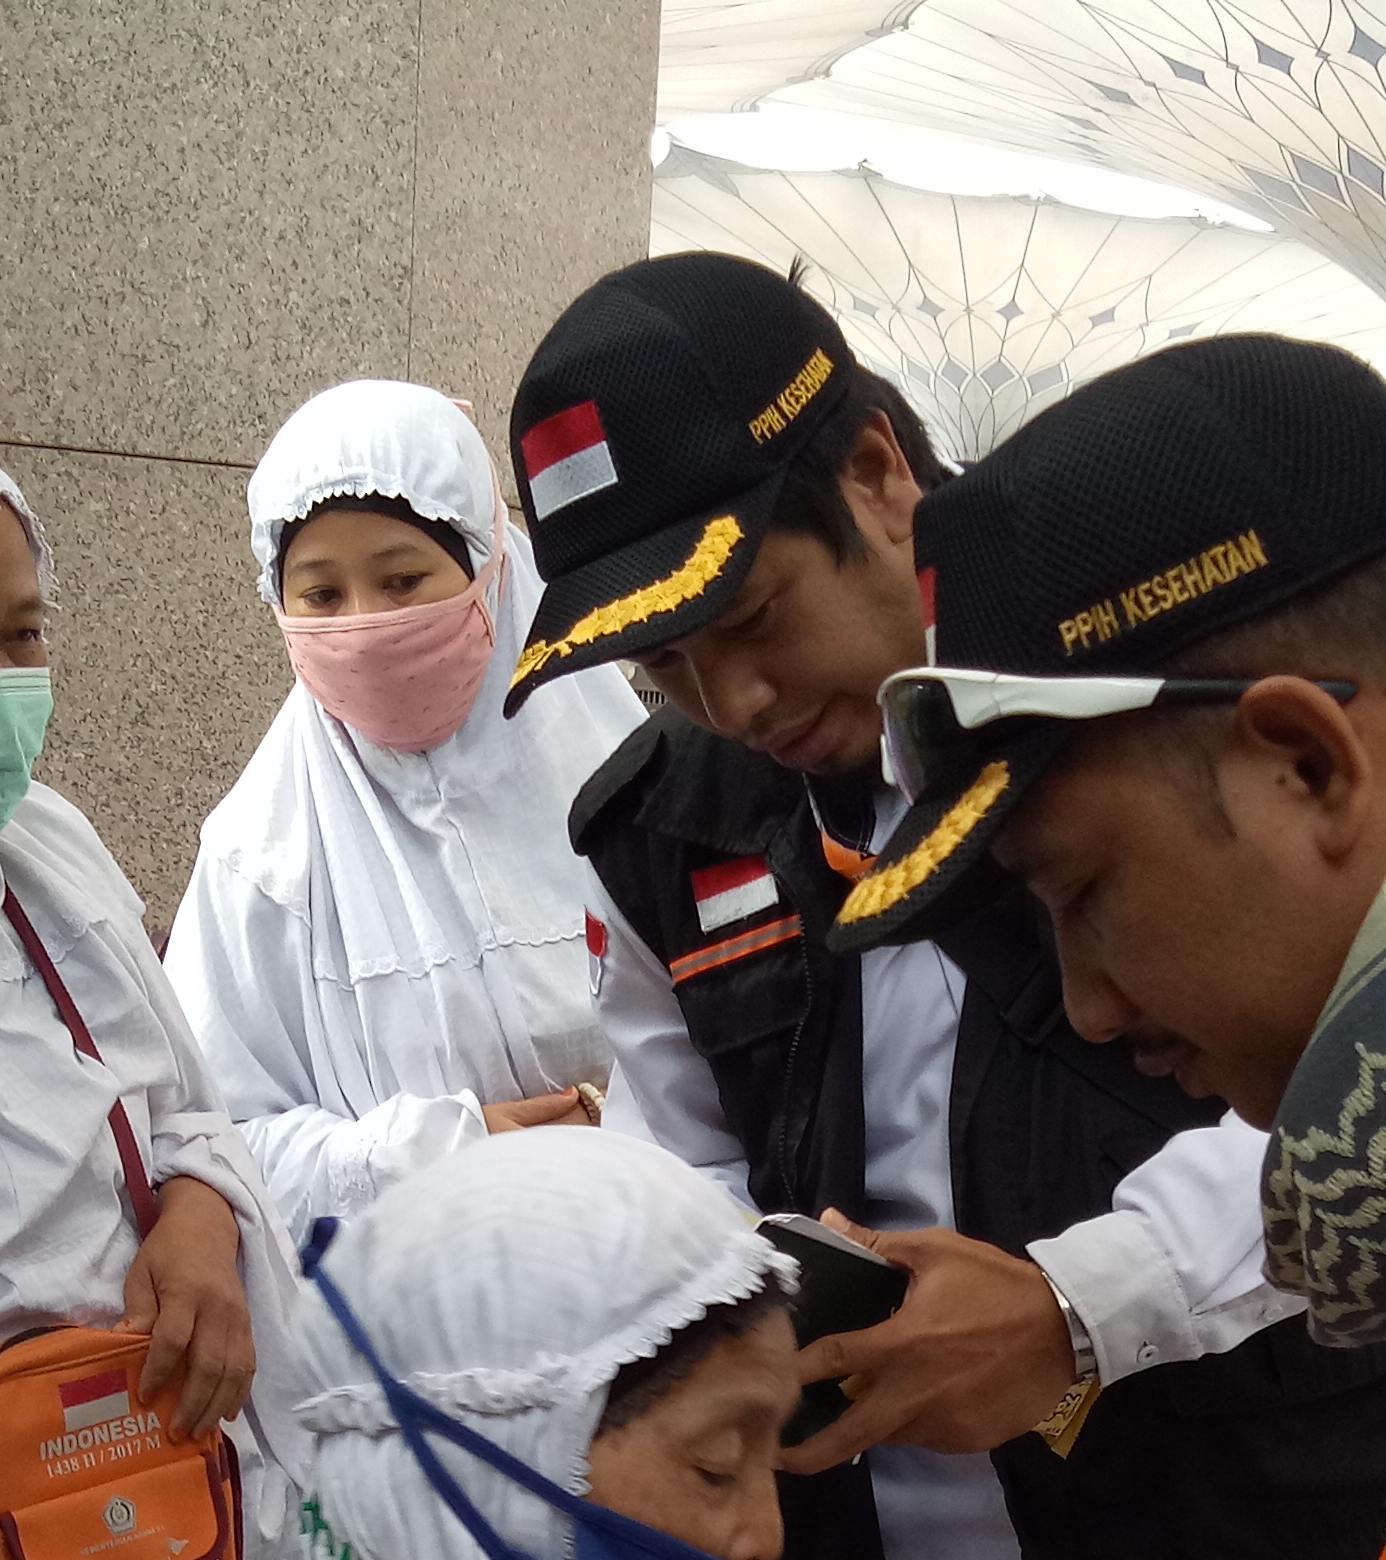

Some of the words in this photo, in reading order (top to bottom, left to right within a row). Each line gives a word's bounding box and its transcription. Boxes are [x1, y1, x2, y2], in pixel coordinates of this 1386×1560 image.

[748, 404, 787, 445] PPIH
[1058, 598, 1121, 656] PPIH
[1119, 528, 1269, 629] KESEHATAN
[39, 1411, 162, 1461] INDONESIA
[47, 1458, 80, 1478] 1438
[82, 1452, 96, 1468] H
[108, 1439, 142, 1461] 2017
[146, 1434, 161, 1450] M
